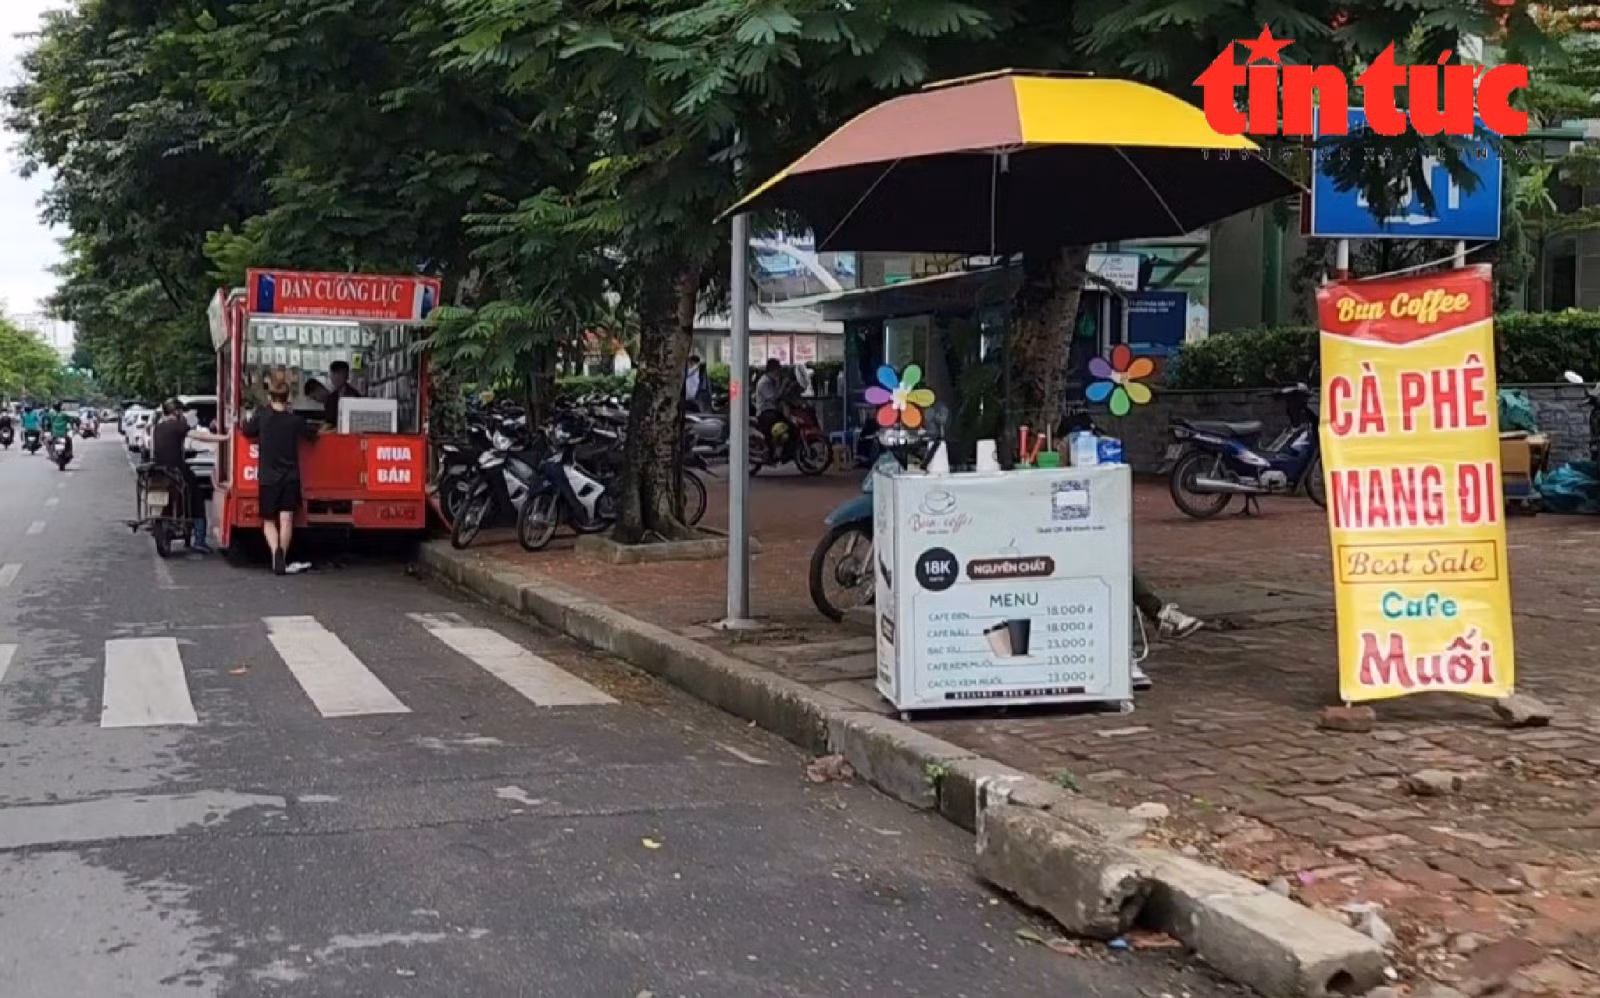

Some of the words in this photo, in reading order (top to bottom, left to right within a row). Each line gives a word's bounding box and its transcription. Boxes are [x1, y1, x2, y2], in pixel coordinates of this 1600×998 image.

[1336, 297, 1385, 322] Bun
[1390, 288, 1471, 324] Coffee
[1328, 361, 1386, 436] CÀ
[1400, 353, 1488, 431] PHÊ
[376, 446, 412, 461] MUA
[376, 467, 411, 483] BÁN
[1330, 465, 1444, 528] MANG
[1457, 462, 1496, 523] ĐI
[923, 560, 951, 575] 18K
[973, 561, 1017, 575] NGUYÊN
[1348, 552, 1411, 576] Best
[1422, 549, 1485, 576] Sale
[989, 591, 1038, 608] MENU
[1382, 590, 1458, 619] Cafe
[1359, 629, 1494, 688] Muối
